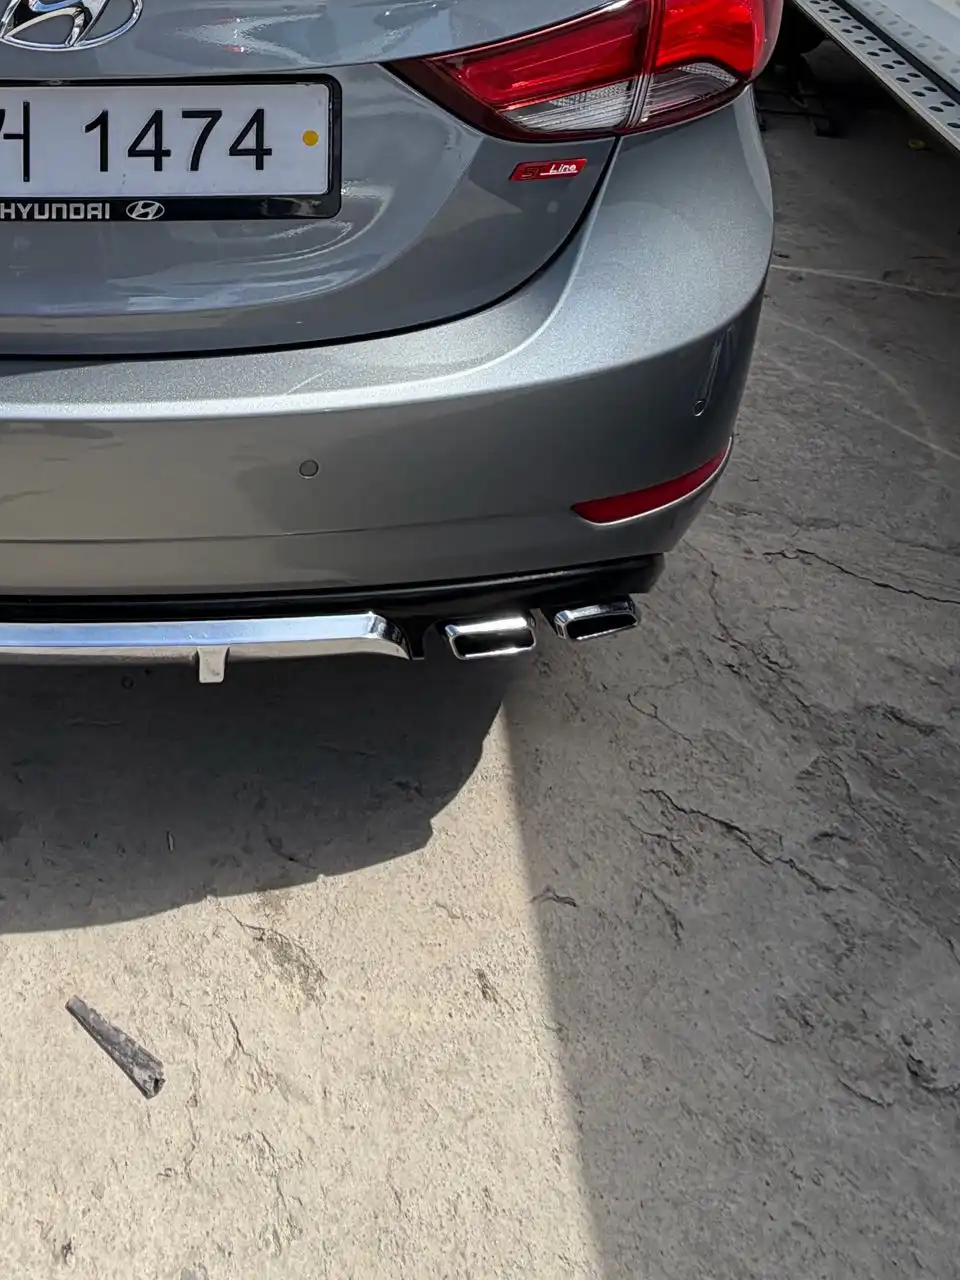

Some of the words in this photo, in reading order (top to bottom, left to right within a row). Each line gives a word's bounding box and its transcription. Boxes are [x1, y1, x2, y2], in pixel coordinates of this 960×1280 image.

[84, 108, 273, 172] 1474
[549, 164, 577, 174] Line
[0, 203, 110, 220] HYUNDAI
